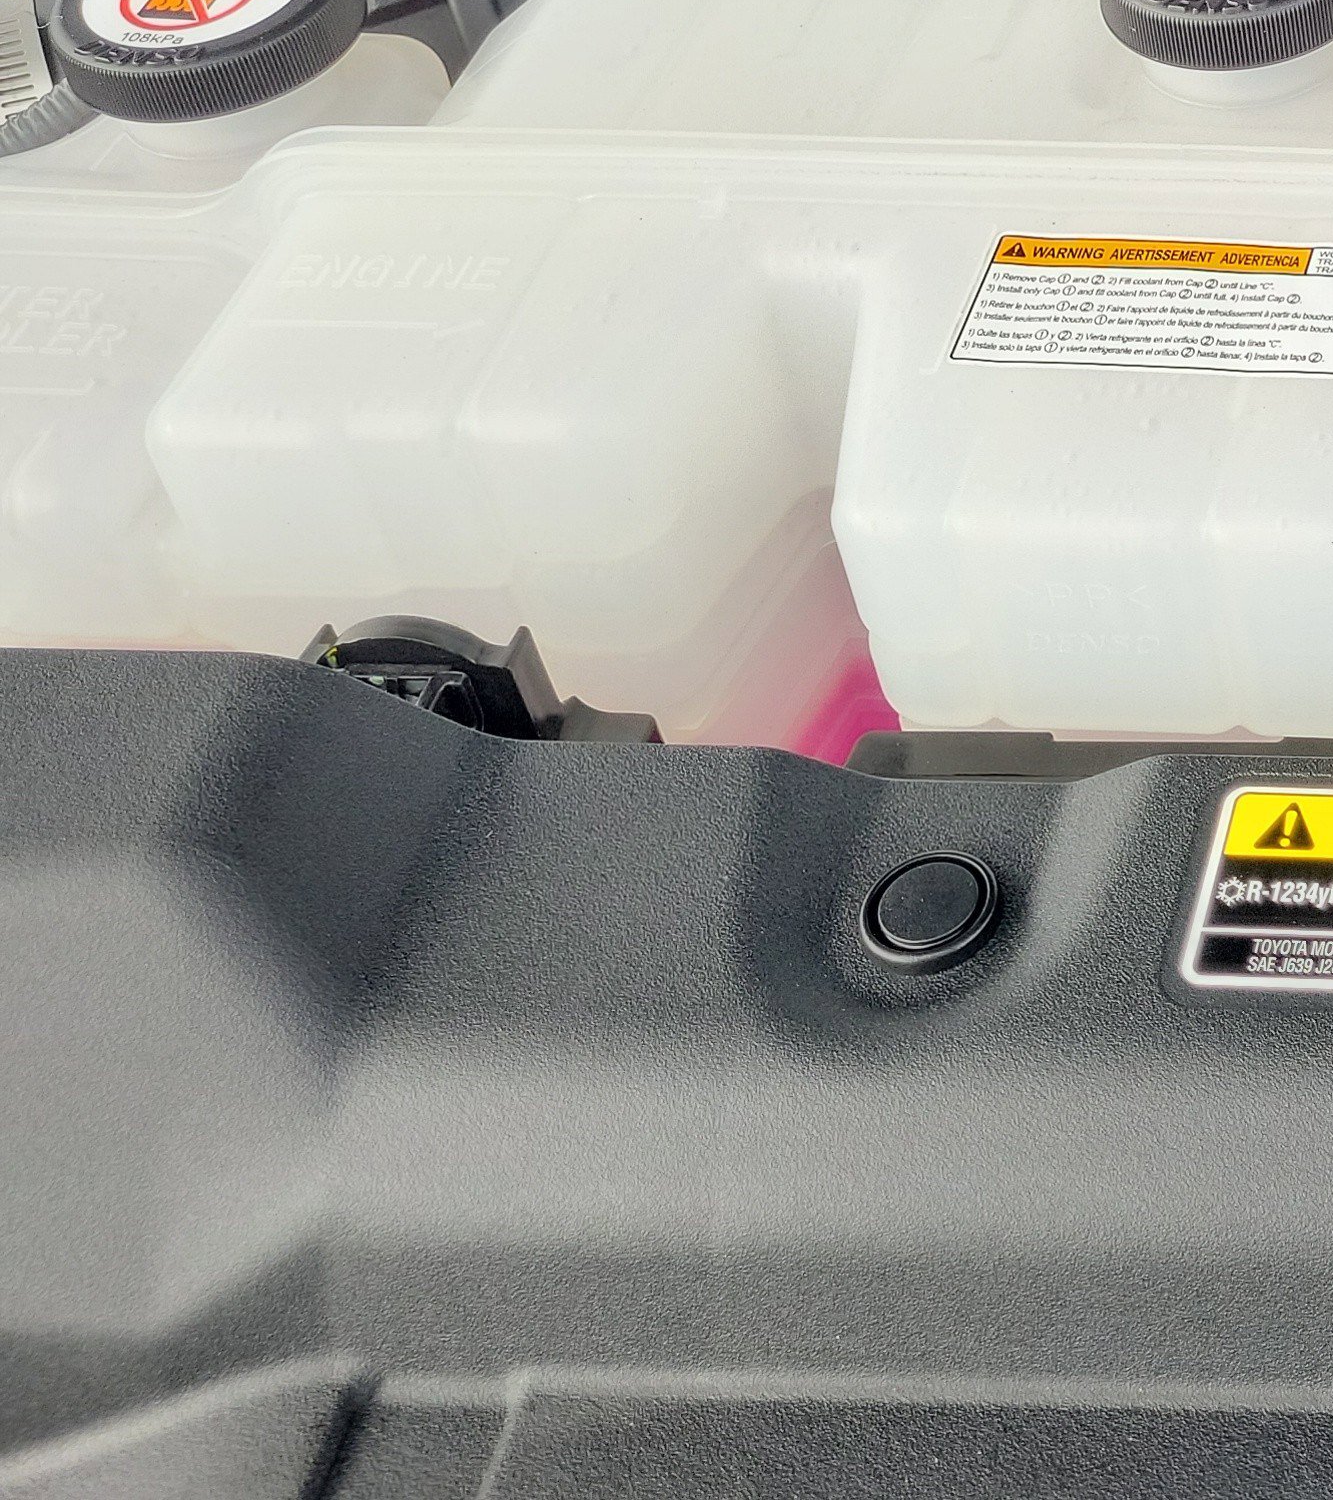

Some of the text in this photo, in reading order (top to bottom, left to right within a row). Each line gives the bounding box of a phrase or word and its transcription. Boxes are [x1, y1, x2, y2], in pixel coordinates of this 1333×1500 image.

[120, 31, 186, 46] 108kPa
[1032, 245, 1299, 267] WARNING AVERTISSEMENT ADVERTENCIA
[279, 254, 510, 290] ENGINE
[1252, 938, 1311, 956] TOYOTA
[1246, 956, 1277, 974] SAE
[1277, 957, 1314, 975] J639
